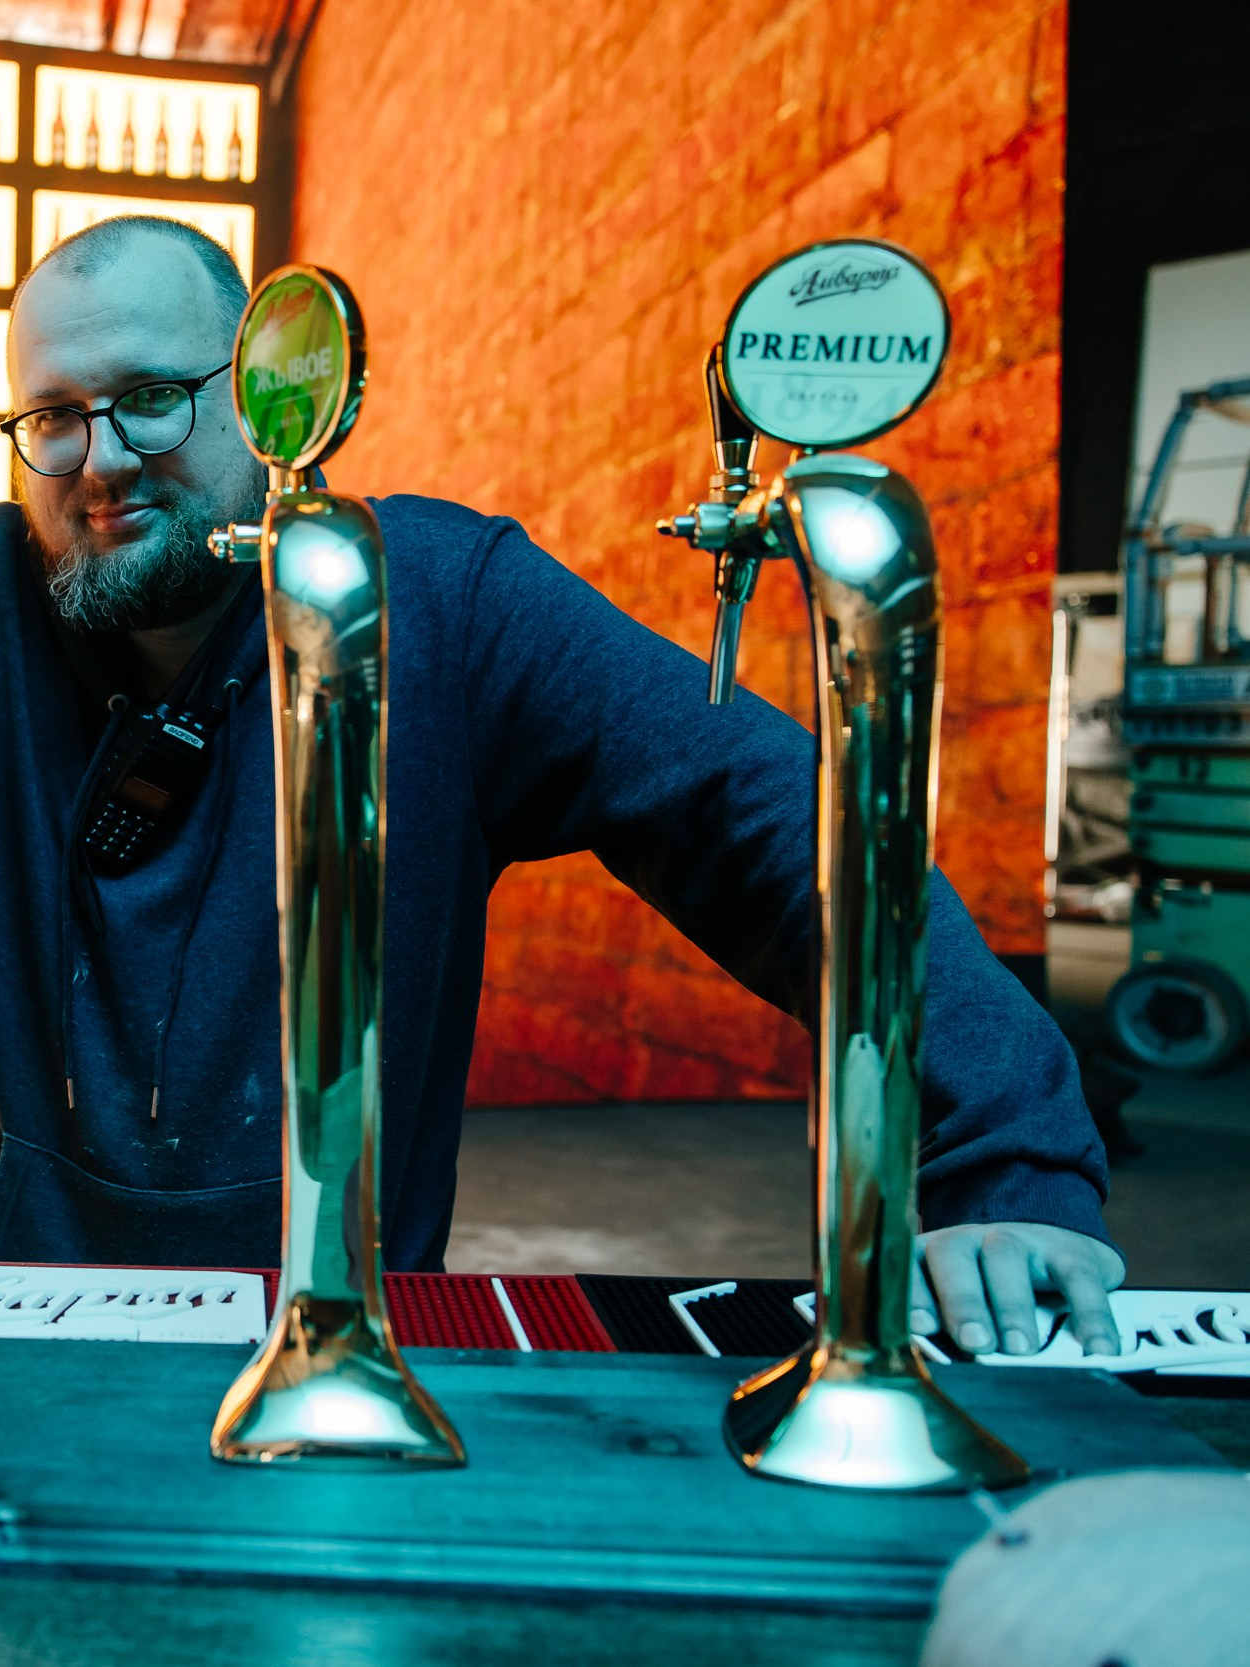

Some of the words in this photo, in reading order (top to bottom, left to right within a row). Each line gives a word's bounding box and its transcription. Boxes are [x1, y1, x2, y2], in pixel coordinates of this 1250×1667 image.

[736, 331, 932, 364] PREMIUM
[254, 346, 334, 395] ЖЫВОЕ
[168, 726, 200, 745] BAOFENG
